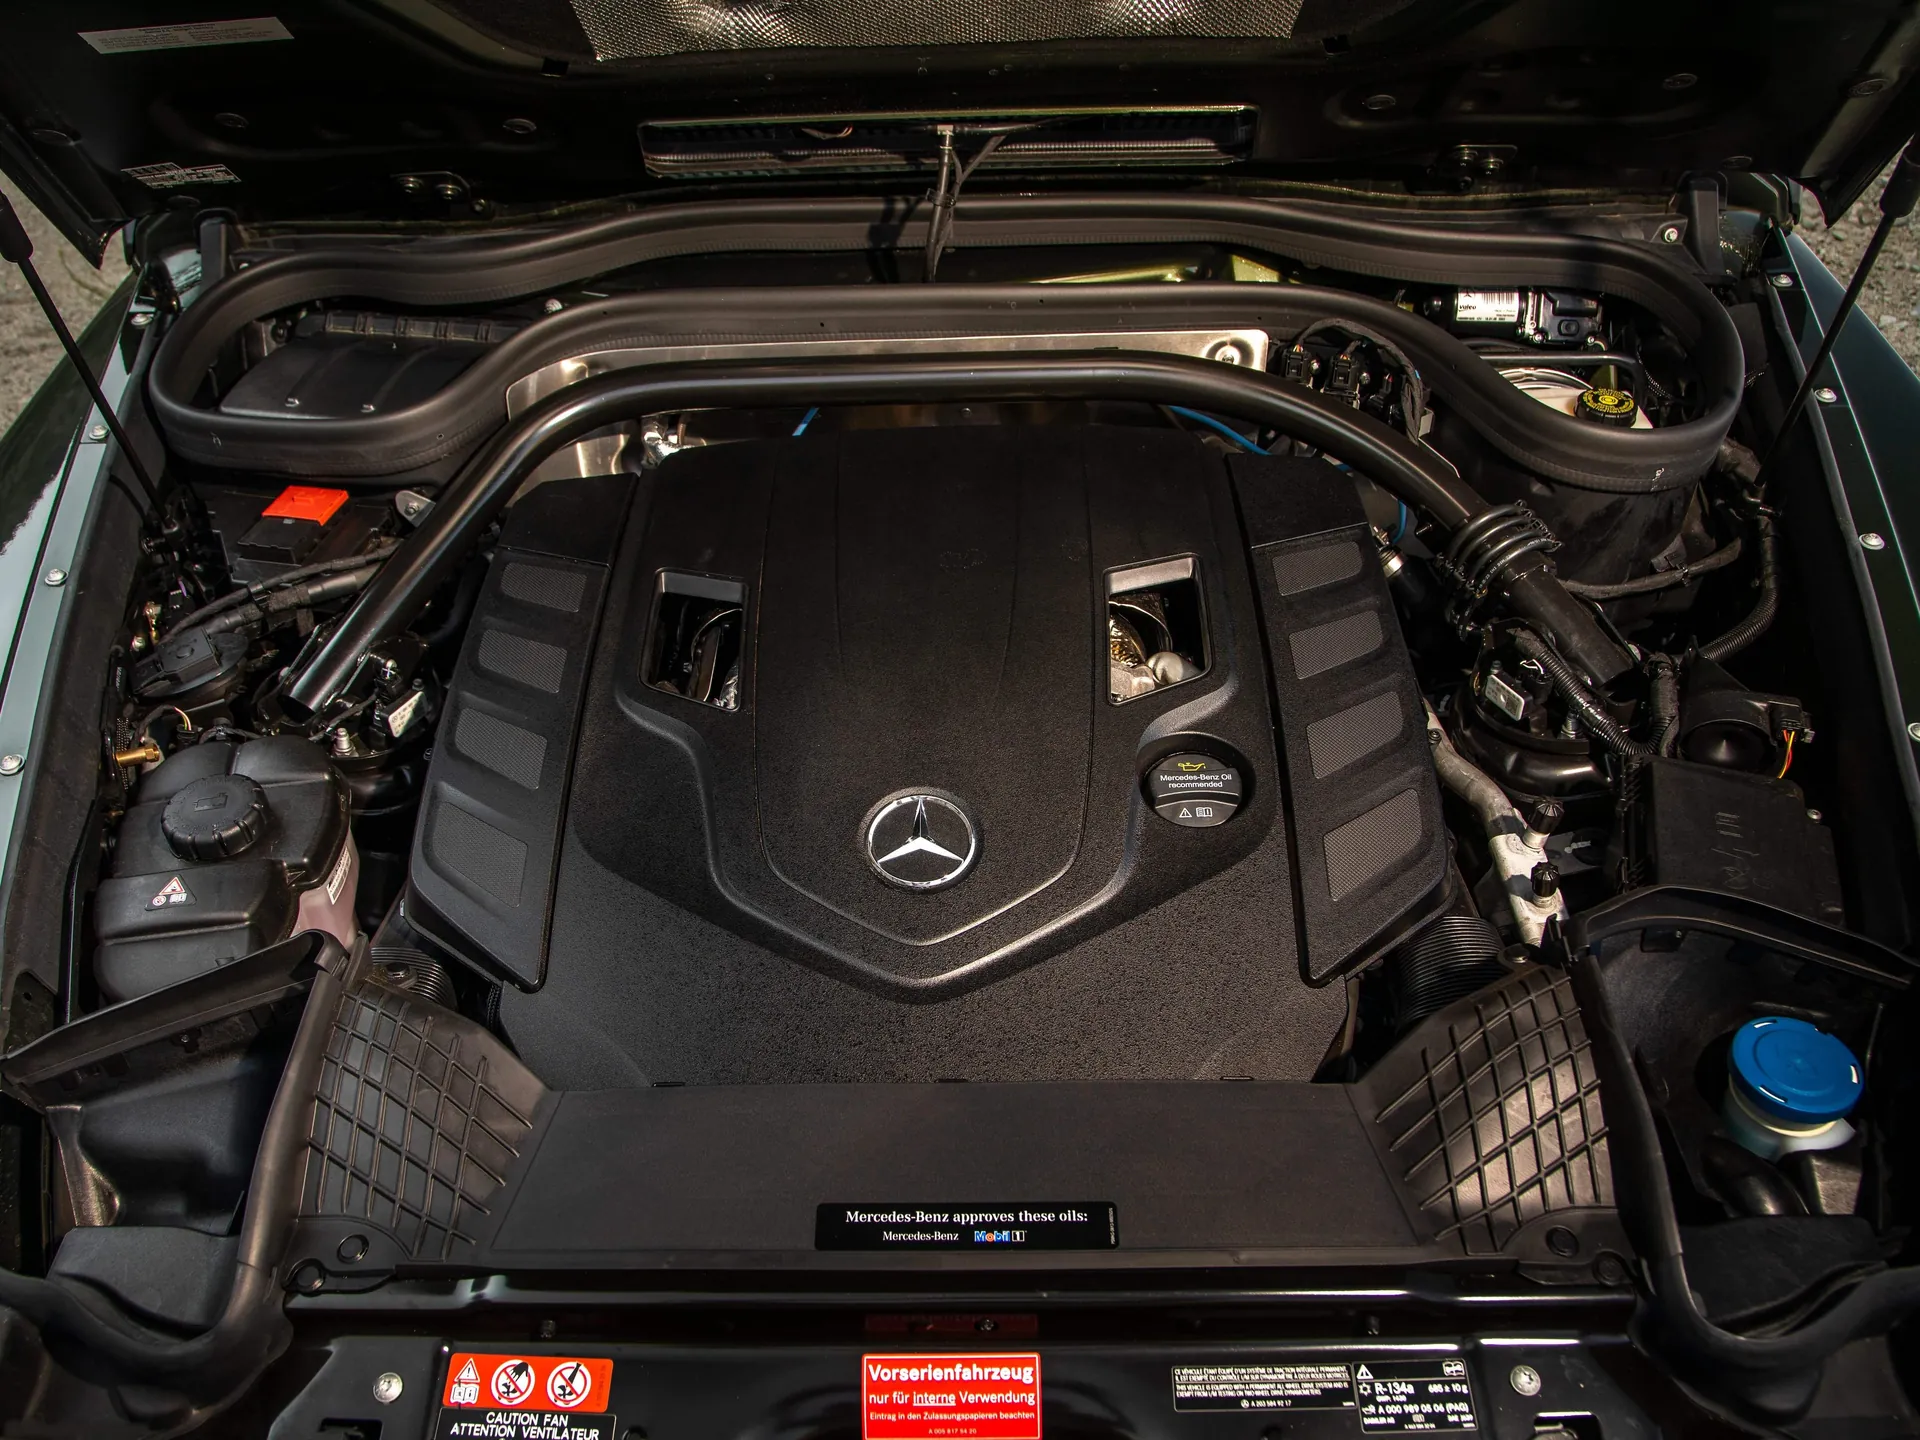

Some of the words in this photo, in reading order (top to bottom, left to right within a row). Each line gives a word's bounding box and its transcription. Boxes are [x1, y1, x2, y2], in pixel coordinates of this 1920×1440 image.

[845, 1211, 949, 1223] Mercedes-Benz
[953, 1212, 1014, 1225] approves
[1018, 1211, 1055, 1222] these
[1059, 1210, 1088, 1222] oils:
[882, 1231, 959, 1241] Mercedes-Benz
[974, 1230, 1010, 1242] Mobil
[868, 1364, 1034, 1384] Vorserienfahrzeug
[1374, 1382, 1415, 1394] R-134a
[1452, 1383, 1461, 1392] 10
[869, 1394, 889, 1404] nur
[892, 1392, 910, 1404] für
[913, 1392, 956, 1405] interne
[959, 1391, 1035, 1406] Verwendung
[1378, 1405, 1385, 1414] A
[1386, 1404, 1402, 1414] 000
[1403, 1404, 1420, 1414] 989
[1433, 1403, 1445, 1413] 06
[1446, 1402, 1469, 1414] (PAG)
[486, 1412, 538, 1426] CAUTION
[543, 1414, 569, 1426] FAN
[870, 1412, 896, 1422] Eintrag
[898, 1412, 905, 1420] in
[907, 1412, 921, 1420] den
[923, 1412, 998, 1421] Zulassungspapieren
[450, 1422, 516, 1438] ATTENTION
[522, 1426, 600, 1440] VENTILATEUR
